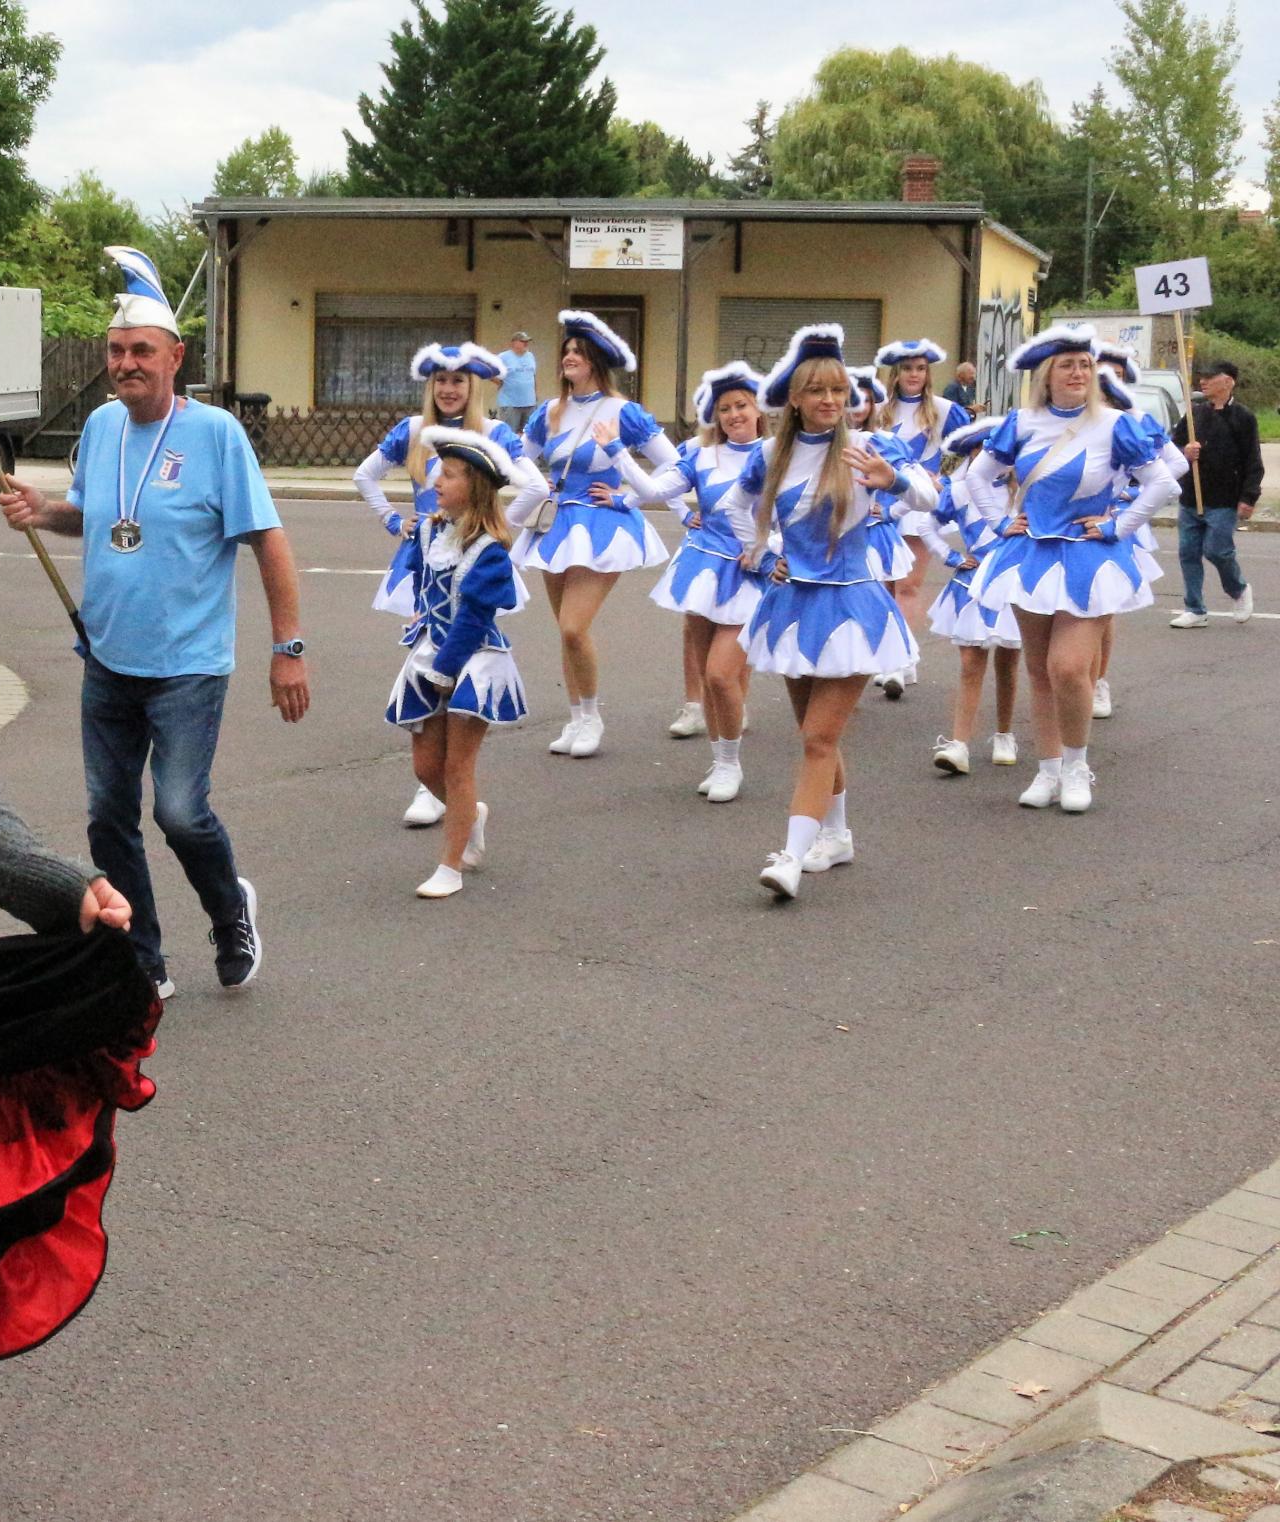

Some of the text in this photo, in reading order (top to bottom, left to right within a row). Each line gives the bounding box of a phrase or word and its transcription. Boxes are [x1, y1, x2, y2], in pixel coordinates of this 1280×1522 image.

[574, 225, 646, 234] Ingo Jänsch
[1154, 272, 1190, 298] 43
